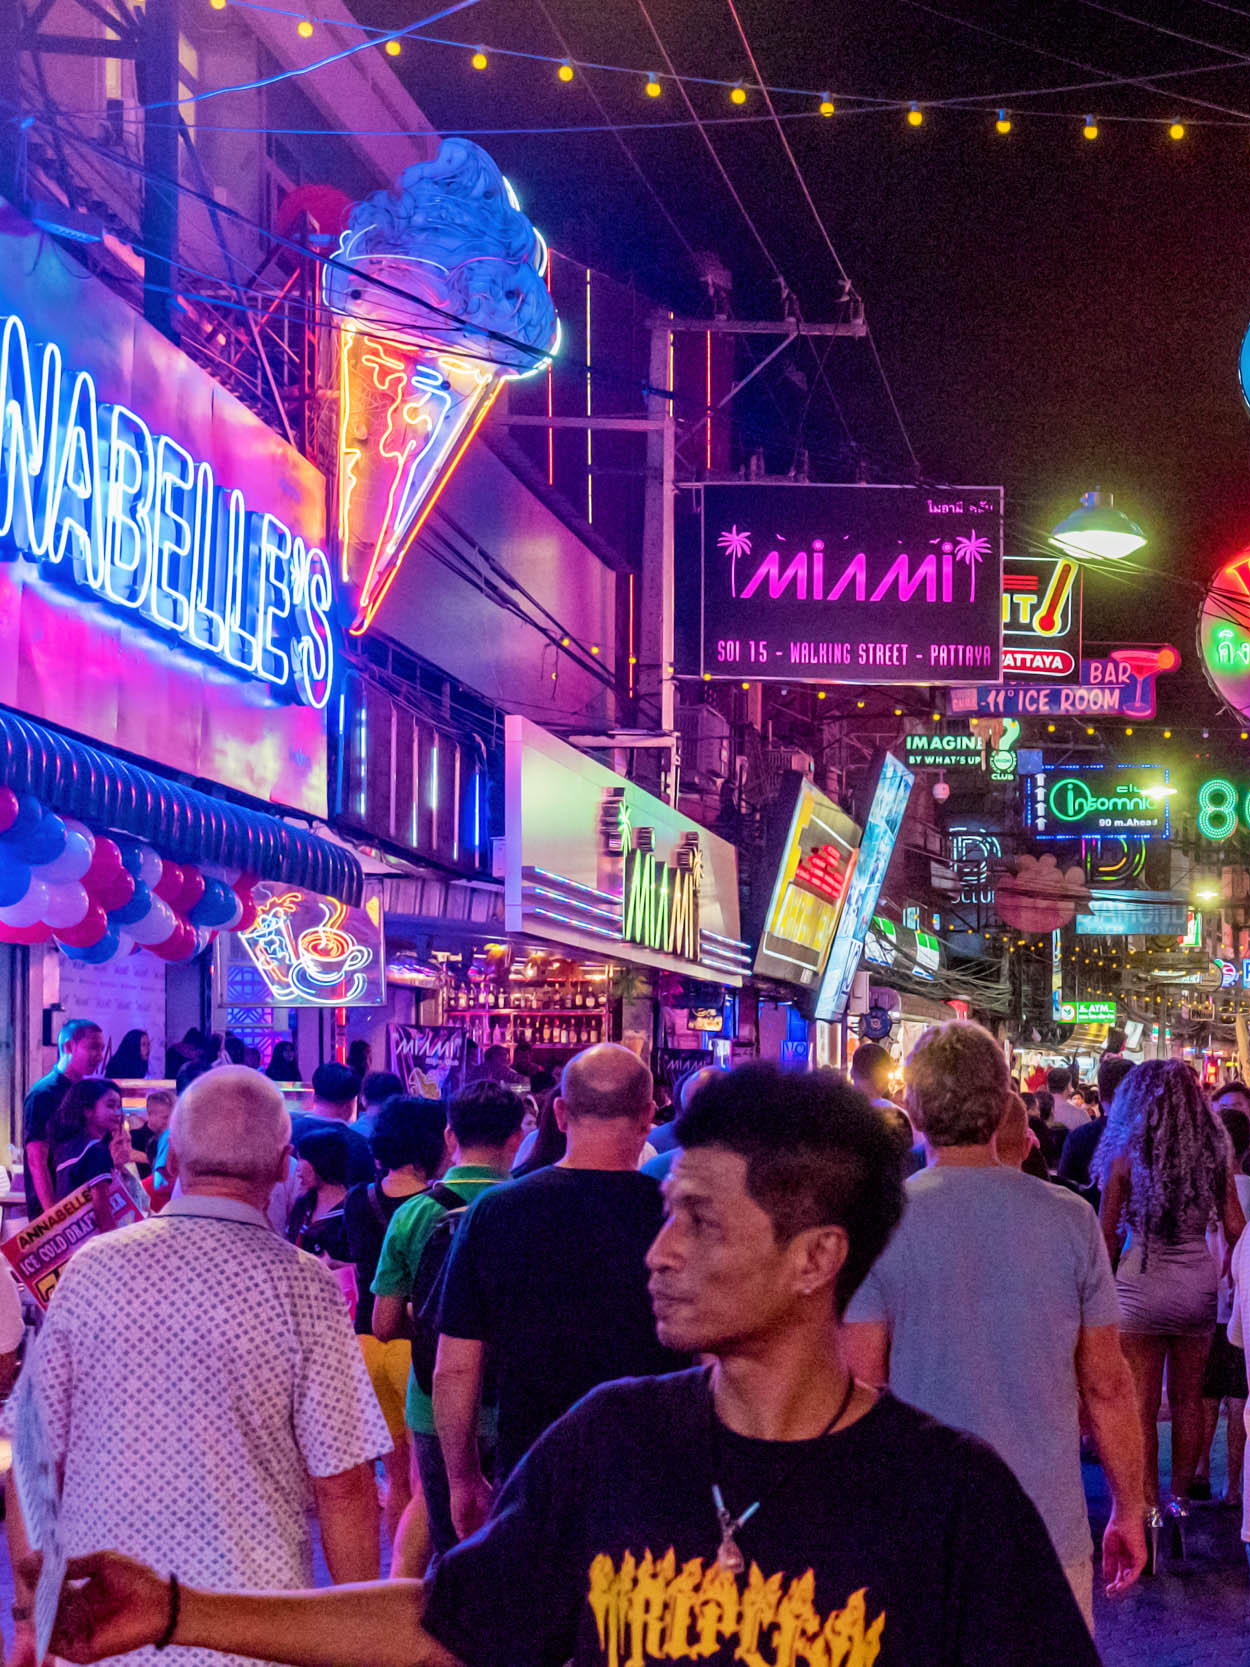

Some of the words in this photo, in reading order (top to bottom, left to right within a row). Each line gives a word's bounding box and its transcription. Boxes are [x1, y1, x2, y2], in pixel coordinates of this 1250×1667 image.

[717, 640, 740, 662] SOI
[749, 641, 767, 662] 15
[790, 642, 850, 664] WALKING
[858, 643, 908, 665] STREET
[930, 645, 991, 667] PATTAYA
[1002, 652, 1063, 670] ATTAYA
[1089, 662, 1132, 685] BAR
[1018, 688, 1050, 712] ICE
[1060, 687, 1120, 711] ROOM
[909, 756, 922, 764] BY
[17, 1186, 94, 1250] ANNABELLE'
[18, 1252, 42, 1277] ICE
[37, 1233, 69, 1262] COLD
[63, 1208, 97, 1244] DRAF
